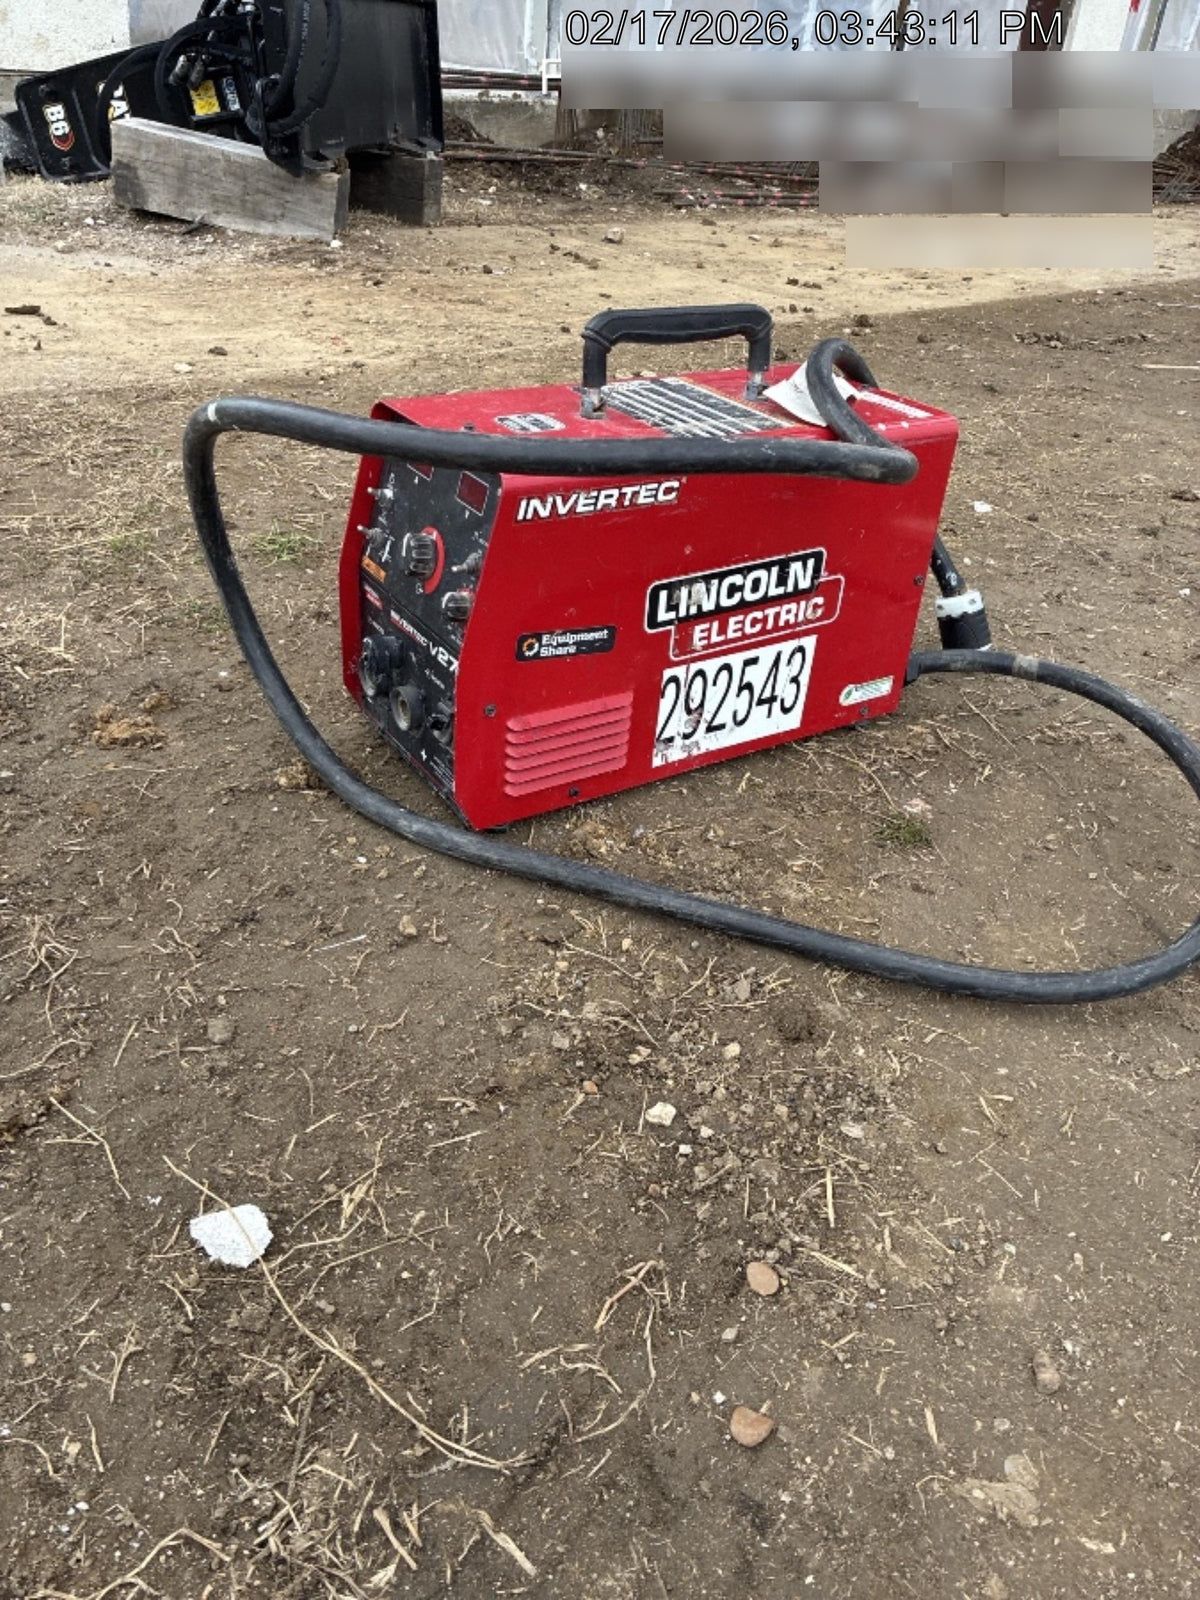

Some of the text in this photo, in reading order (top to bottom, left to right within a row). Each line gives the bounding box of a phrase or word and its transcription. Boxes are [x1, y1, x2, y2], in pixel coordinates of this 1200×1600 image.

[516, 479, 680, 522] INVERTEC
[656, 557, 815, 622] LINCOLN
[540, 628, 609, 646] Equipment
[692, 596, 825, 647] ELECTRIC
[539, 645, 577, 657] Share
[659, 644, 806, 744] 292543
